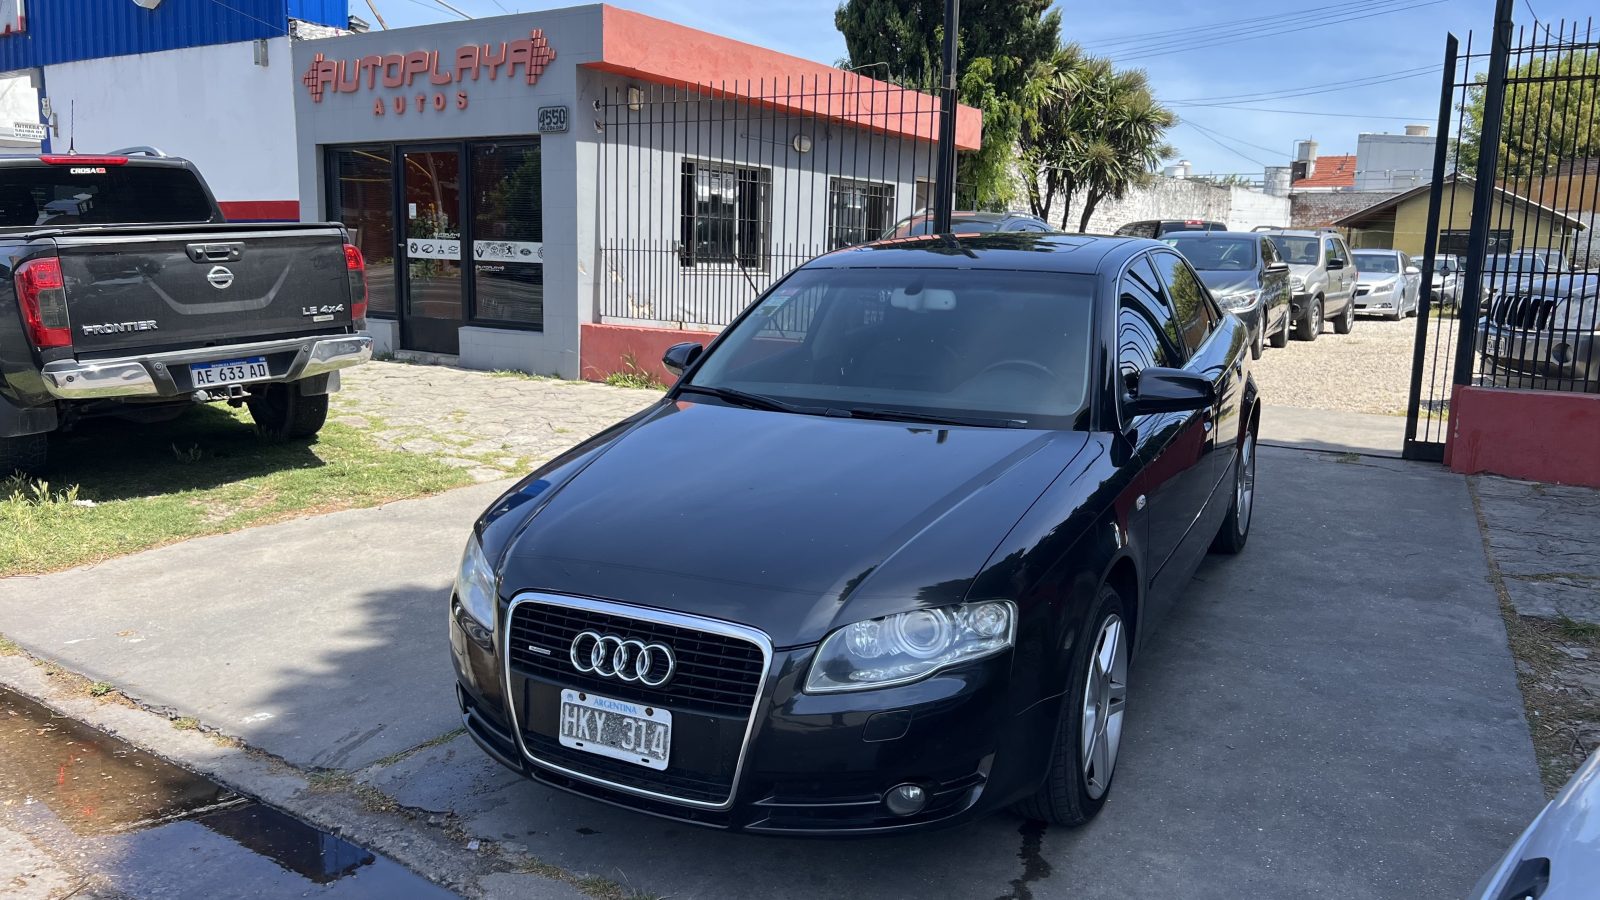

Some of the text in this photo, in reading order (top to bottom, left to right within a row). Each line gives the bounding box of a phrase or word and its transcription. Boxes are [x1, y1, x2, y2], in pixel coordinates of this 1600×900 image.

[316, 39, 535, 93] AUTOPLAYA
[372, 90, 469, 117] AUTOS
[539, 108, 565, 126] 4550
[302, 306, 318, 315] LE
[82, 319, 159, 336] FRONTIER
[197, 364, 266, 385] AE 633 AD
[593, 698, 637, 714] ARGENTINA
[563, 704, 667, 760] HKY 314
